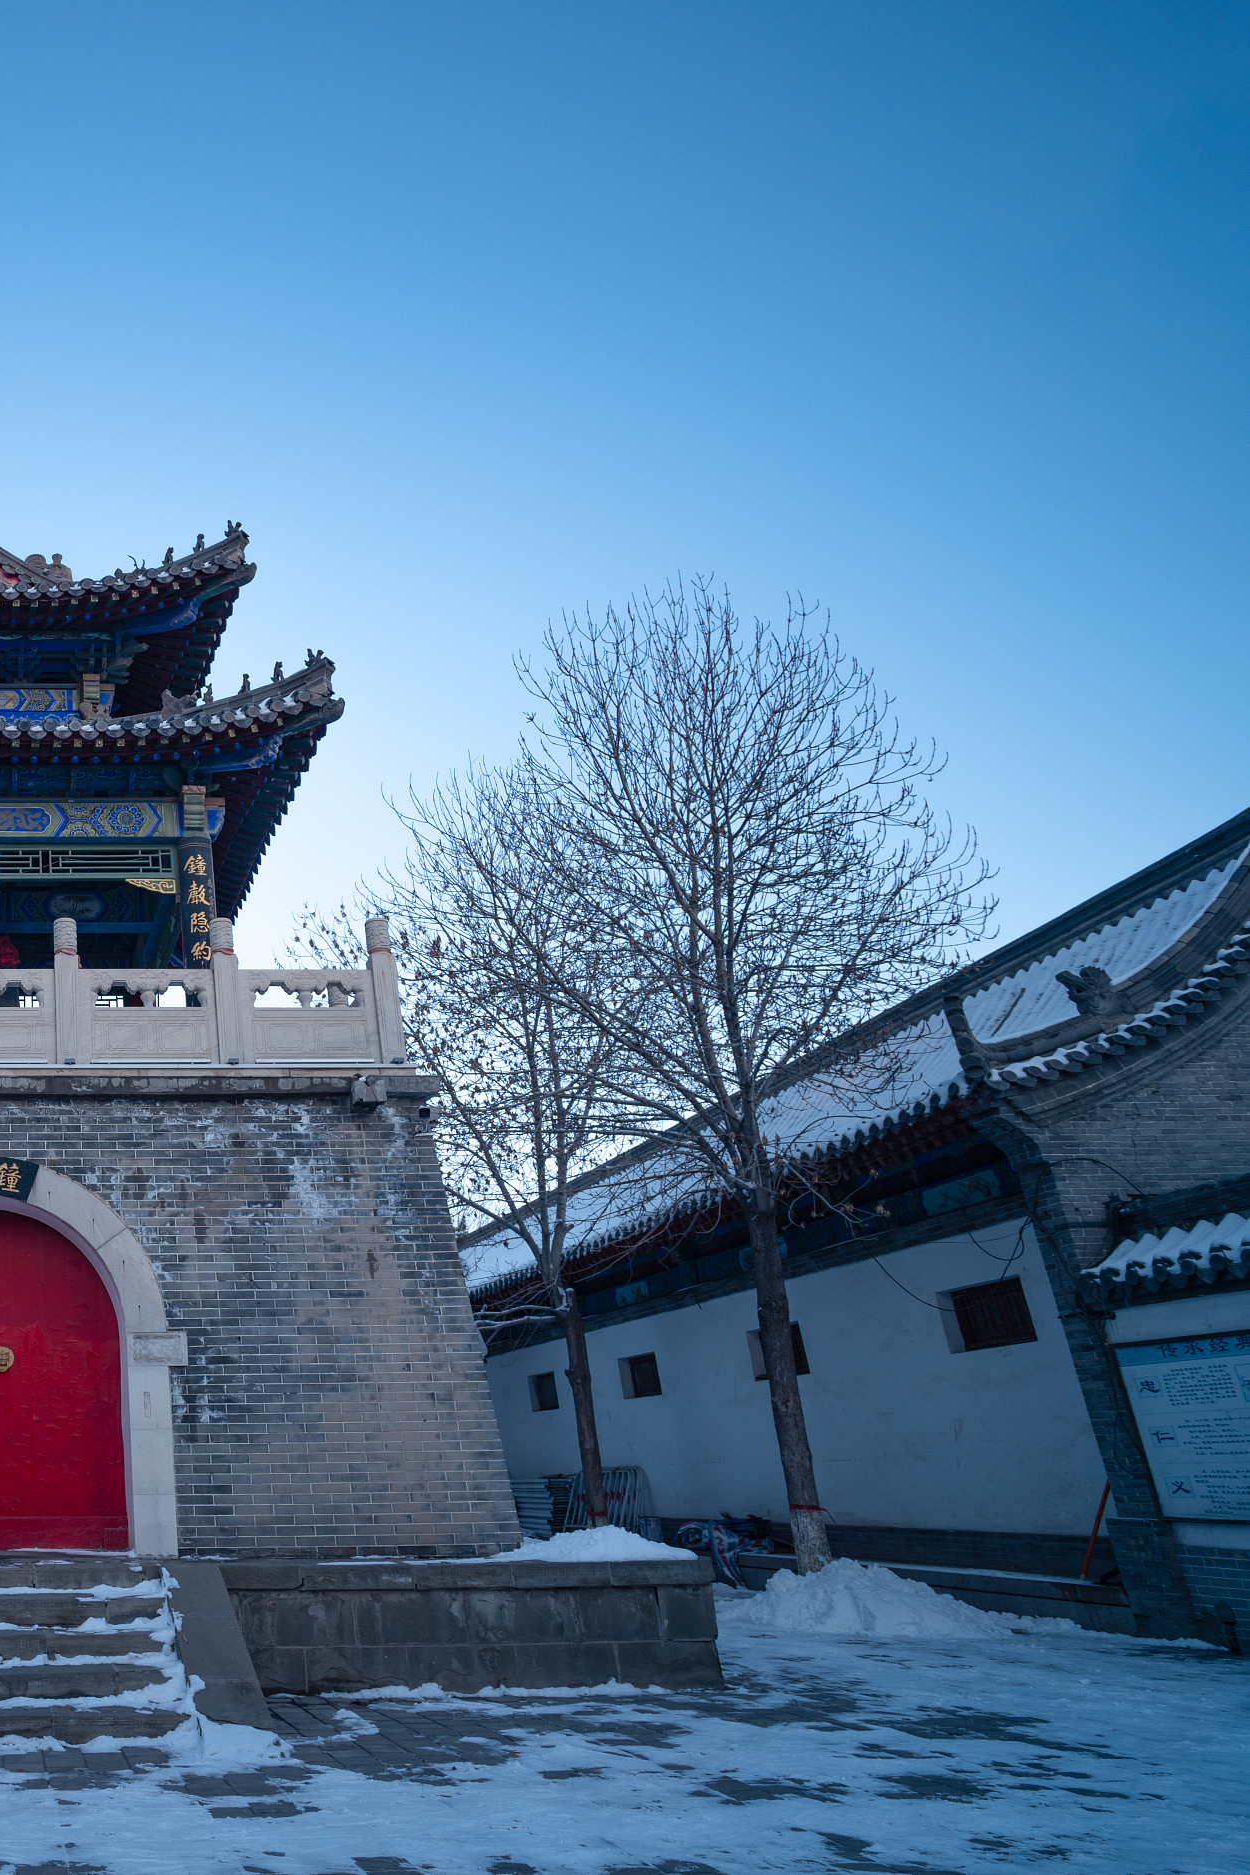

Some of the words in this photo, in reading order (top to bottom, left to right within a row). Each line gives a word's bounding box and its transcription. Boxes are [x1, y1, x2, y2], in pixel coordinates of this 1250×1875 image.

[1139, 1379, 1161, 1394] 忠
[1152, 1430, 1175, 1444] 仁
[1171, 1480, 1192, 1494] 义
